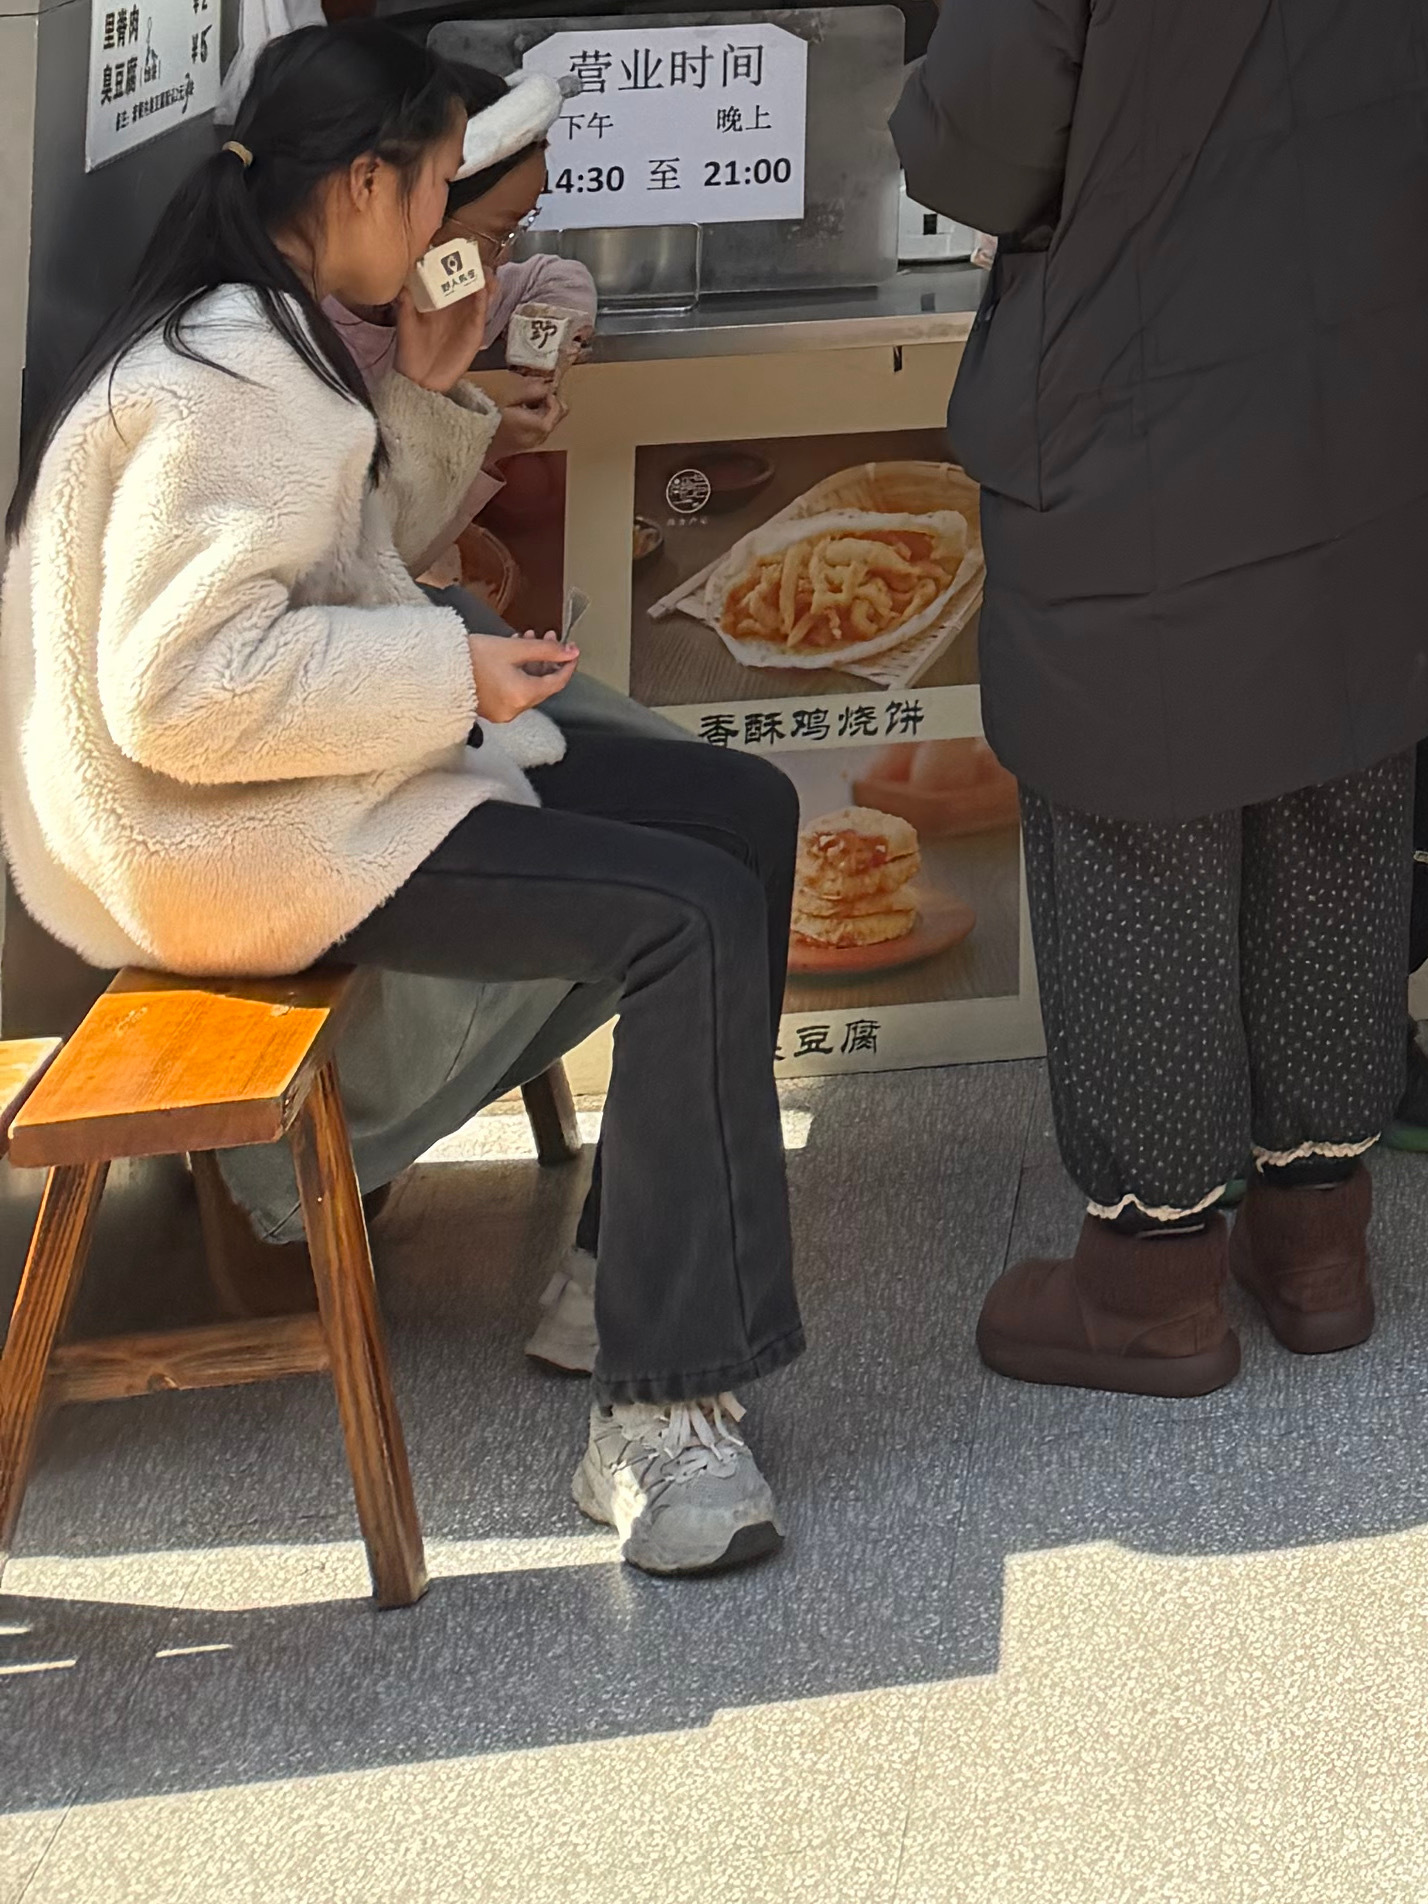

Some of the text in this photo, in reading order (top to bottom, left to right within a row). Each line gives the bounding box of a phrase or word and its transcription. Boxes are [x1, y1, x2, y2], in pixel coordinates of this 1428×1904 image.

[569, 42, 765, 94] 营业时间
[558, 104, 773, 141] 下午 晚上
[646, 156, 681, 191] 至
[703, 157, 792, 187] 21:00
[697, 698, 925, 747] 香酥鸡烧饼
[774, 1018, 882, 1061] 豆腐
